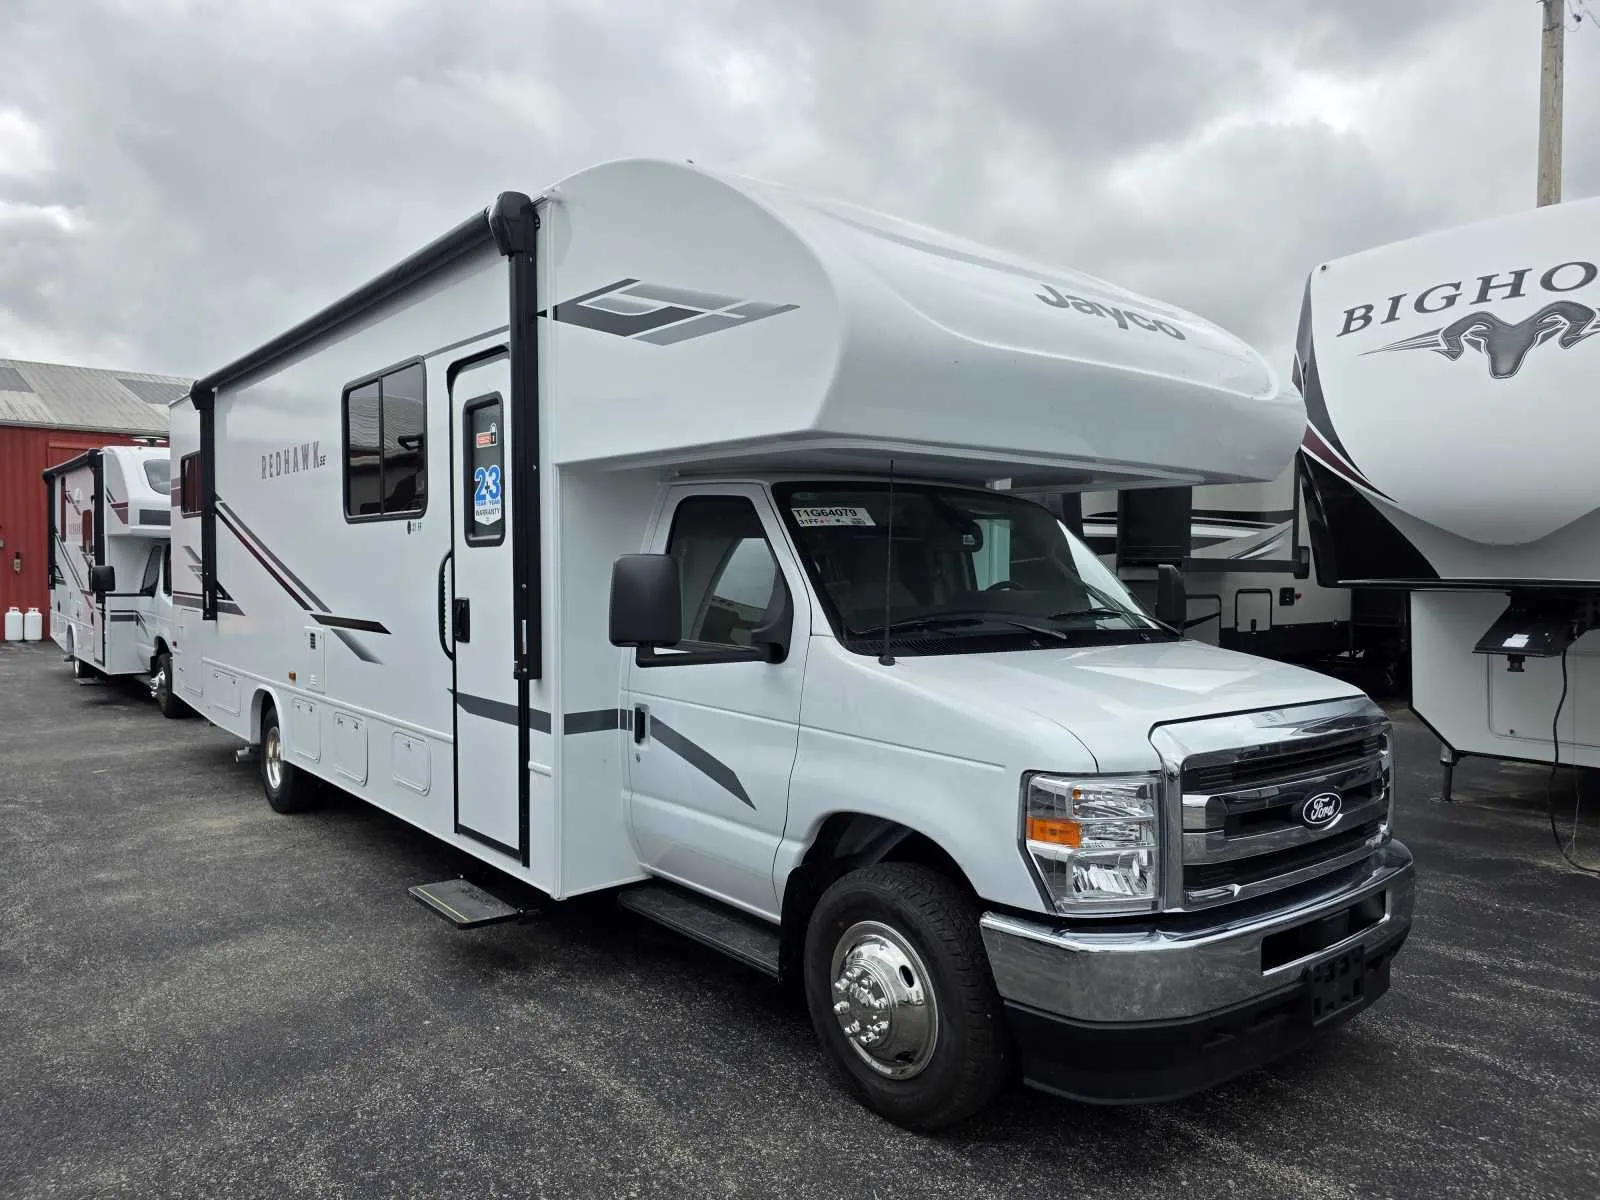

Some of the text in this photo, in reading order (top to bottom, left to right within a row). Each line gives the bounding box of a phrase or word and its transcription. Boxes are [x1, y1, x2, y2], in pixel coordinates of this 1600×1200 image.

[1034, 283, 1186, 341] Jayco
[1336, 261, 1598, 337] BIGHO
[261, 440, 319, 479] REDHAWK
[476, 508, 500, 516] WARRANTY
[1310, 796, 1336, 821] Ford
